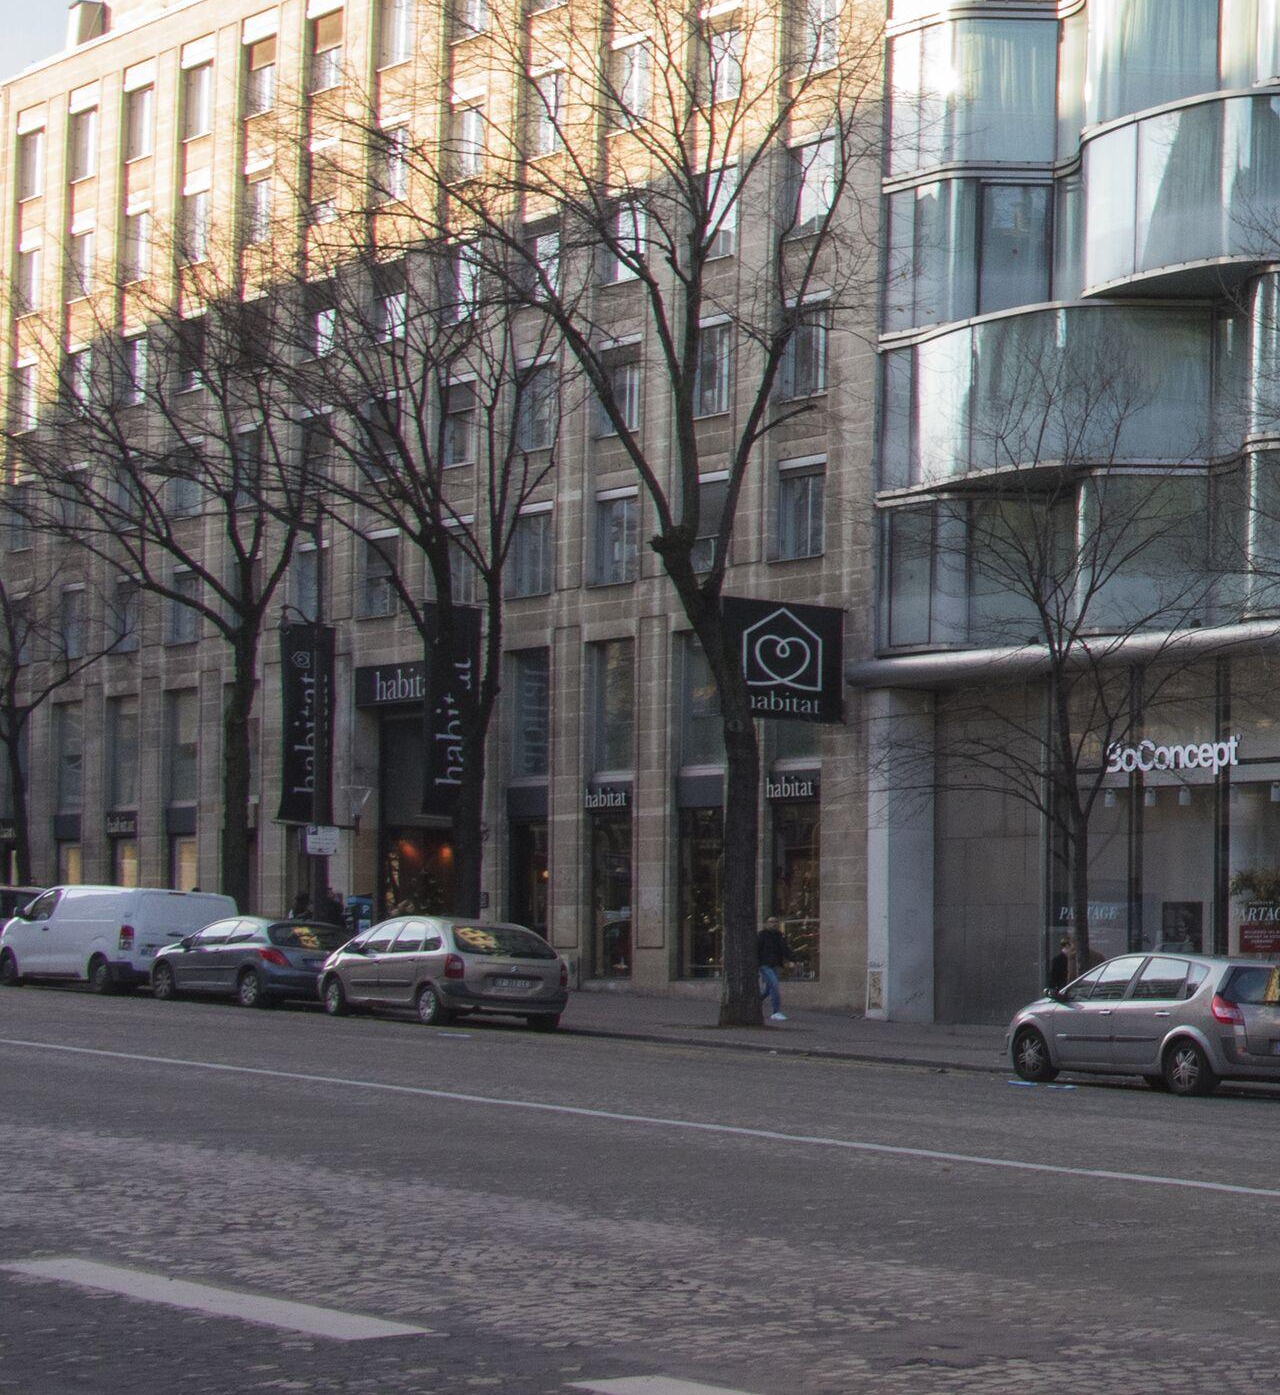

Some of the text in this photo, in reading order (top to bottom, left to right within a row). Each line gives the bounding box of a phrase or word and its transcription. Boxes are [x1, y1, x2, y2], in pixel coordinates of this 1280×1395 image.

[376, 666, 425, 701] habit
[584, 787, 628, 809] habitat
[765, 775, 815, 799] habitat
[1058, 906, 1119, 921] PATAGE
